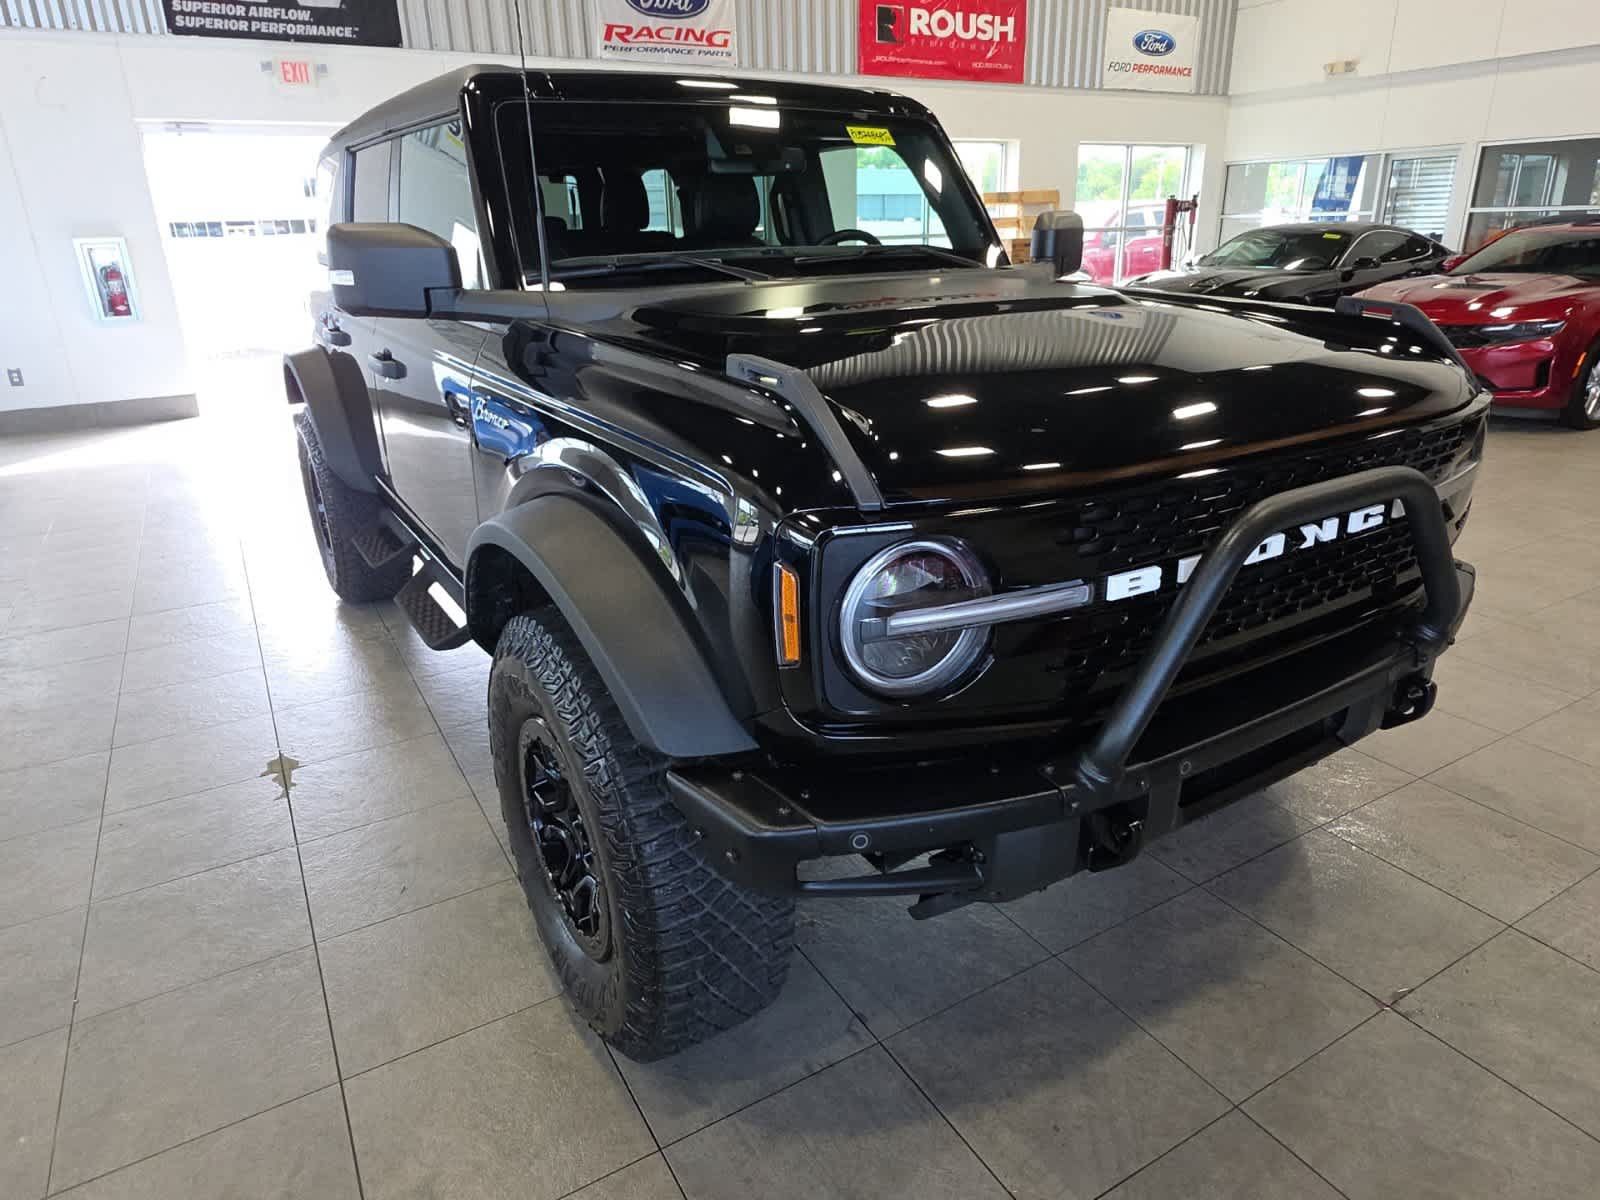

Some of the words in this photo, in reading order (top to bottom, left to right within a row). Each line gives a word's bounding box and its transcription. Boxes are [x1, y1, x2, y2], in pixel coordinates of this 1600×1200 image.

[171, 0, 250, 16] SUPERIOR
[249, 6, 314, 22] AIRFLOW.
[175, 15, 250, 32] SUPERIOR
[910, 7, 1015, 42] ROUSH
[603, 24, 732, 48] RACING
[1141, 33, 1168, 52] Ford
[603, 44, 694, 55] PERFORMANCE
[281, 61, 310, 84] EXIT
[1108, 61, 1131, 73] FORD
[1132, 63, 1192, 77] PERFORMANCE
[475, 396, 509, 430] Bronco
